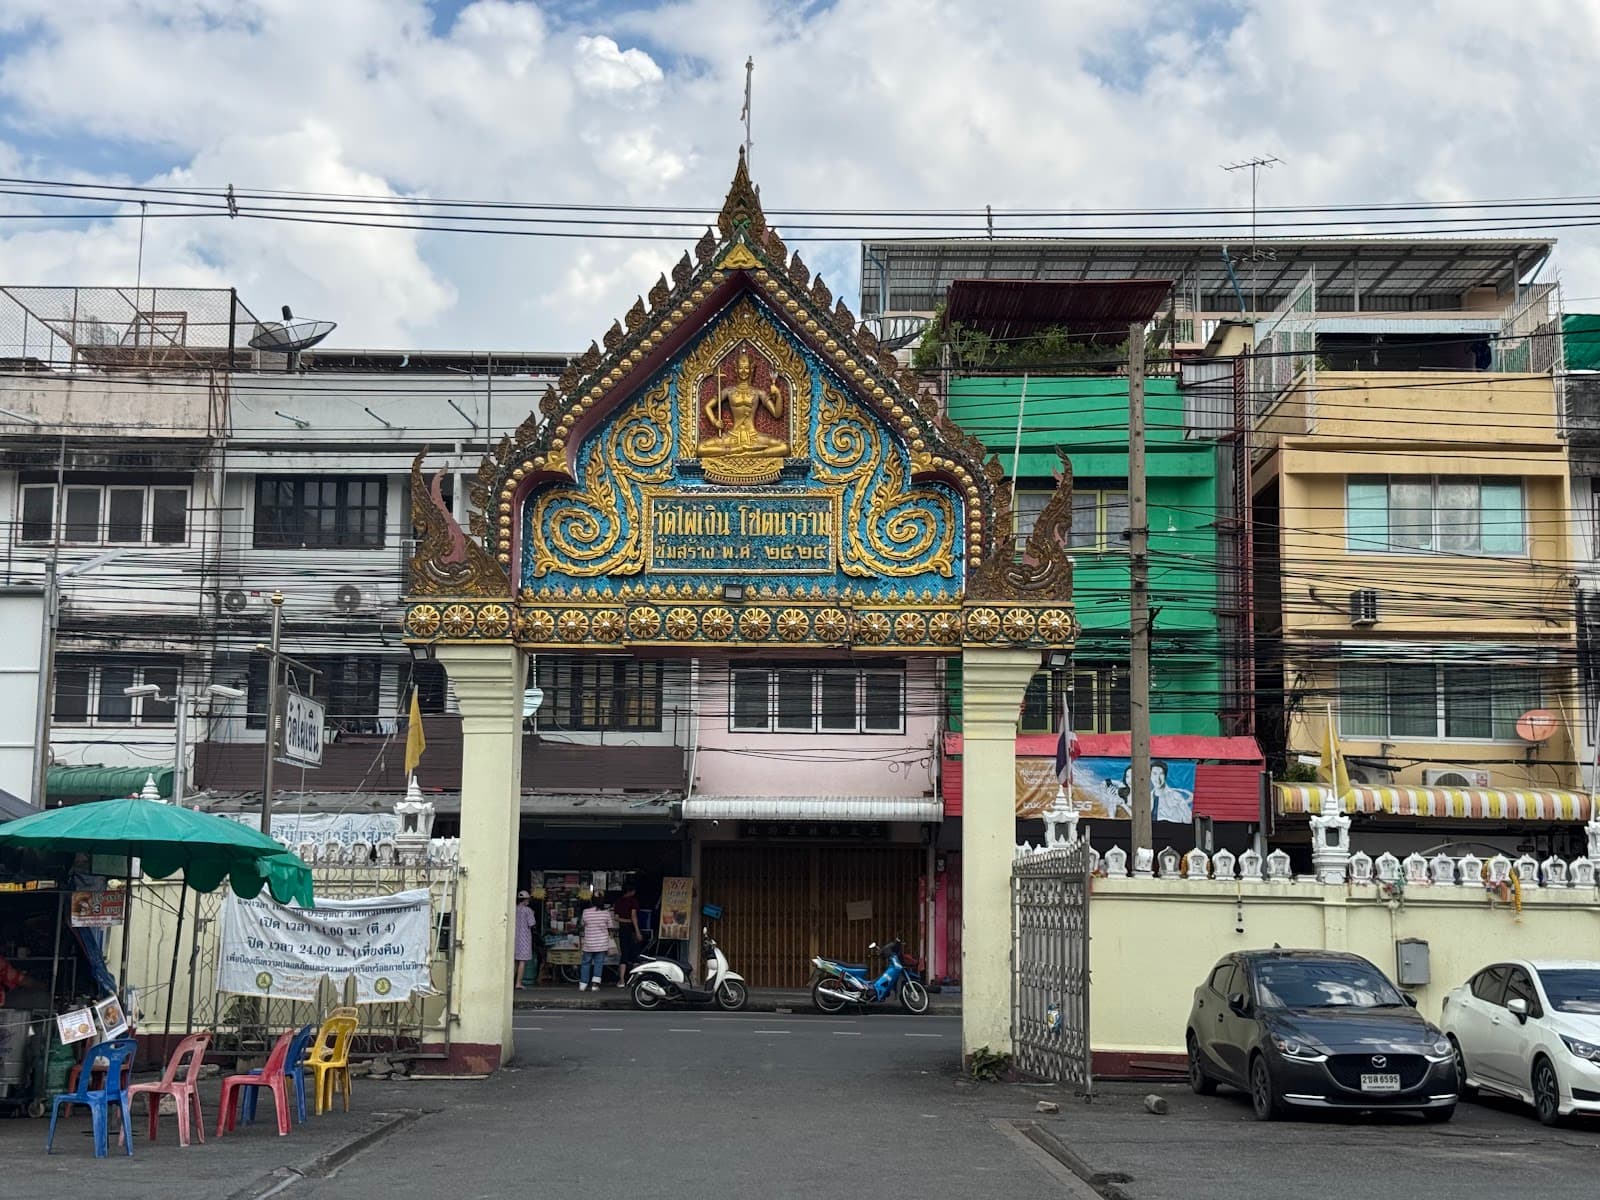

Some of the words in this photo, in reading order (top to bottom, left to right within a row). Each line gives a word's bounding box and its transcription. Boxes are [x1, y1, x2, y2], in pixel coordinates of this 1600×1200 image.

[654, 504, 731, 536] วัดไผ่เงิน
[738, 504, 832, 536] โชตนาราม
[285, 921, 311, 932] เวลา
[269, 941, 294, 952] เวลา
[299, 944, 331, 956] 24.00
